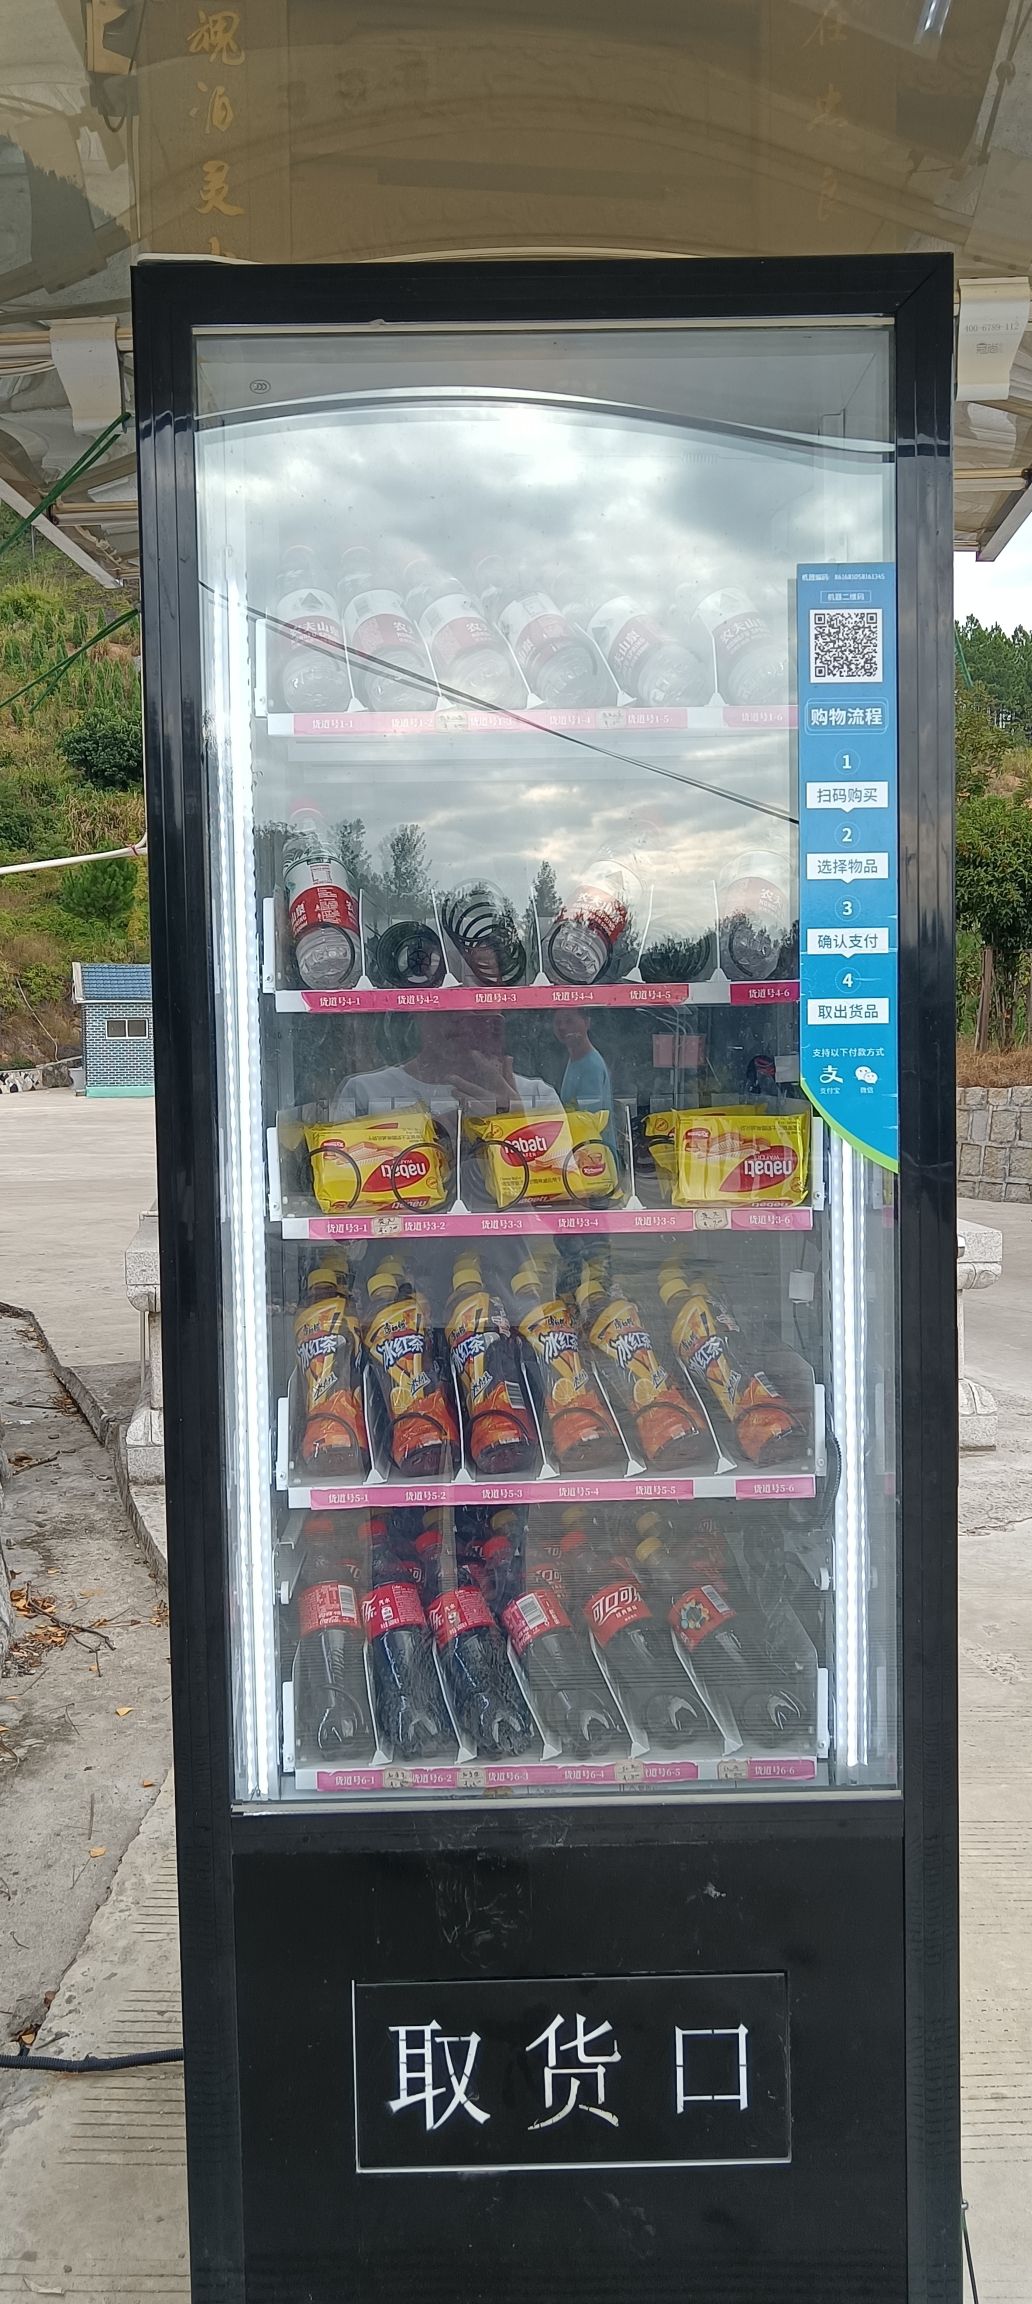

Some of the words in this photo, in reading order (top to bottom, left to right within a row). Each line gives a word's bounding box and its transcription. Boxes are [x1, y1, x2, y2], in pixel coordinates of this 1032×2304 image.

[827, 592, 864, 601] 机器二维码
[810, 707, 883, 727] 购物流程
[842, 755, 852, 769] 1
[816, 786, 878, 804] 扫码购买
[842, 828, 852, 842] 2
[817, 858, 878, 875] 选择物品
[842, 901, 852, 915] 3
[817, 933, 878, 950] 确认支付
[842, 973, 853, 988] 4
[475, 992, 517, 1003] 货道号4-3
[552, 991, 593, 1001] 货道号4-4
[629, 989, 671, 1000] 货道号4-5
[749, 988, 790, 998] 货道号4-6
[319, 997, 361, 1007] 货道号4-1
[397, 995, 439, 1005] 货道号4-2
[817, 1004, 879, 1020] 取出货品
[812, 1047, 885, 1058] 支持以下付款方式
[744, 1160, 793, 1178] nabati
[481, 1219, 523, 1230] 货道号3-3
[558, 1217, 599, 1228] 货道号3-4
[635, 1216, 676, 1226] 货道号3-5
[749, 1214, 790, 1225] 货道号3-6
[327, 1223, 367, 1233] 货道号3-1
[404, 1221, 446, 1231] 货道号3-2
[296, 1334, 338, 1375] 冰红茶
[377, 1334, 424, 1371] 冰红茶
[450, 1333, 485, 1374] 冰红茶
[558, 1486, 599, 1497] 货道号5-4
[635, 1485, 676, 1495] 货道号5-5
[754, 1483, 795, 1493] 货道号5-6
[328, 1493, 368, 1503] 货道号5-1
[405, 1491, 446, 1501] 货道号5-2
[481, 1489, 523, 1499] 货道号5-3
[564, 1769, 604, 1779] 货道号6-4
[645, 1767, 681, 1778] 道号6-5
[755, 1766, 795, 1776] 货道号6-6
[335, 1775, 375, 1786] 货道号6-1
[488, 1772, 529, 1782] 货道号6-3
[387, 2012, 748, 2131] 取货口
